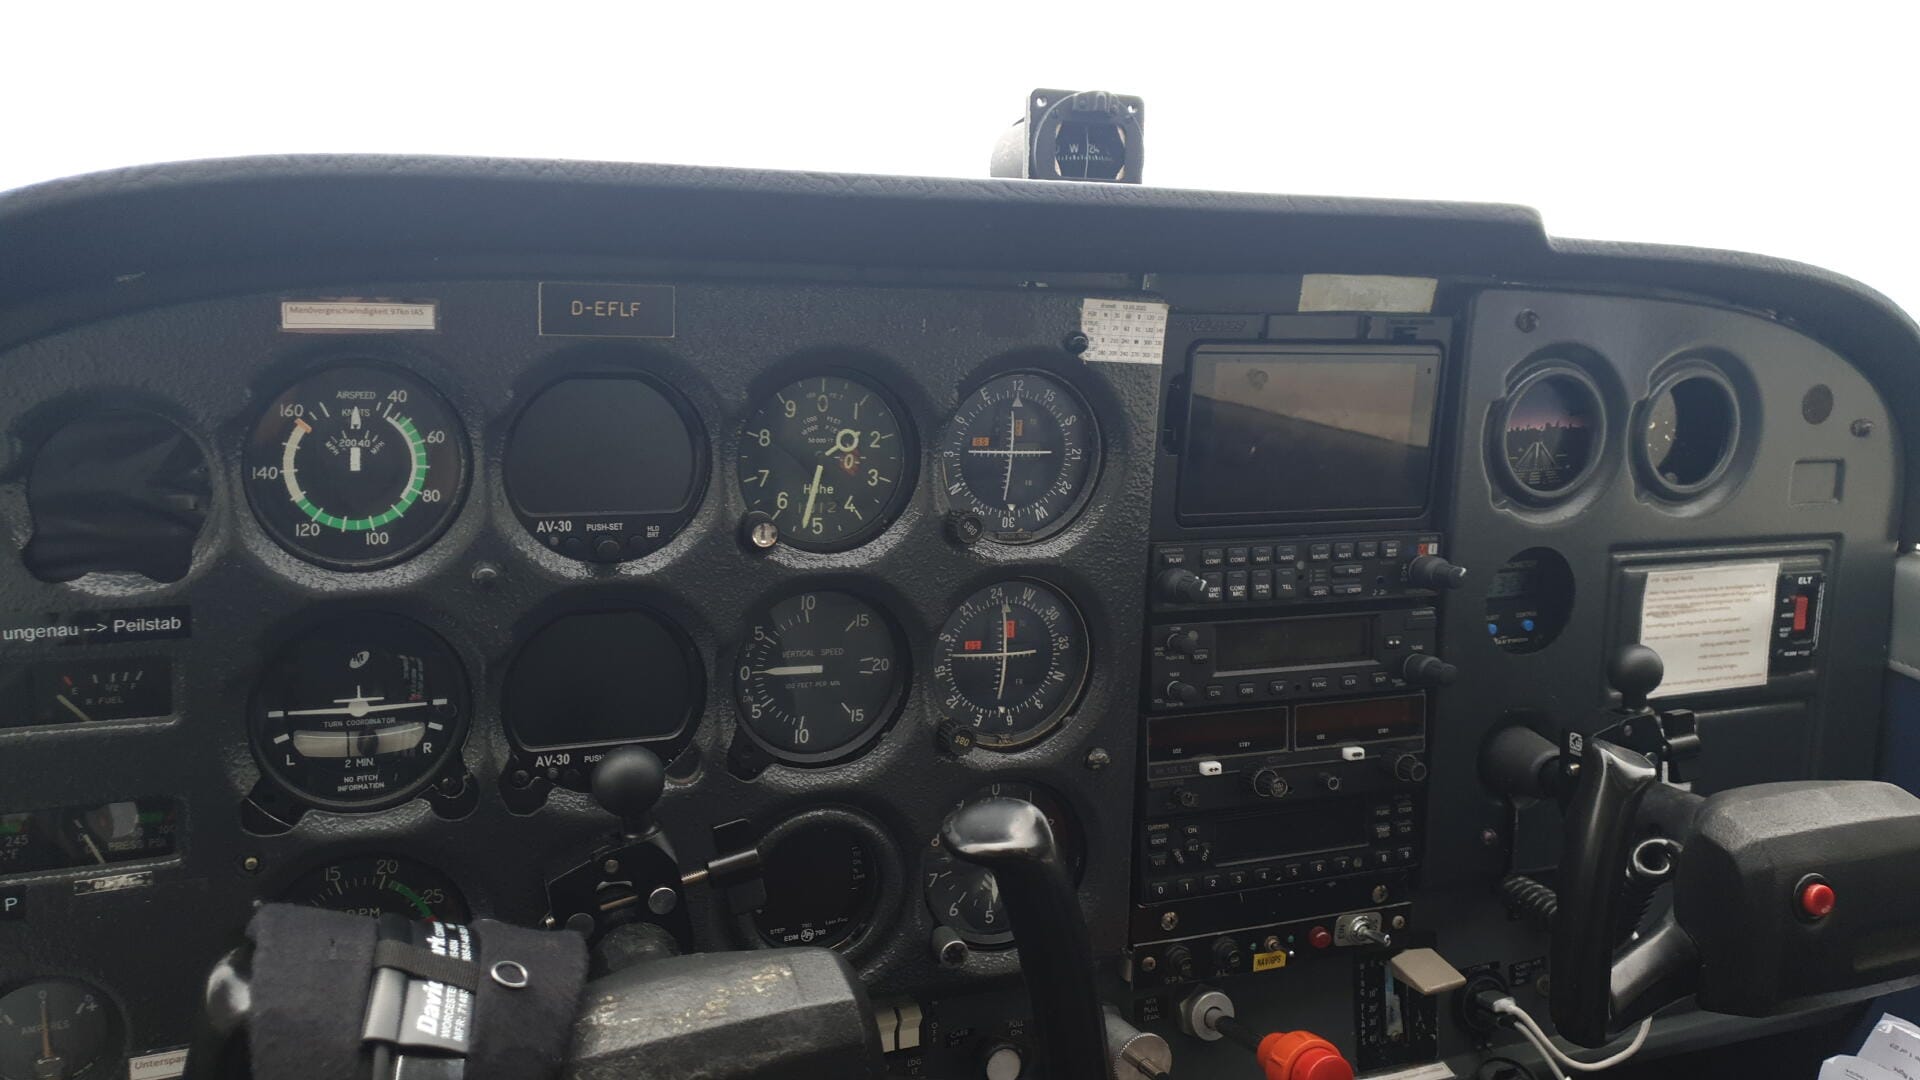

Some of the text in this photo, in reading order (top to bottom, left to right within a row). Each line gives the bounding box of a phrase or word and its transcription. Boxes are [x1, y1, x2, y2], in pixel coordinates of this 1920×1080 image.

[571, 300, 641, 317] D-EFLF
[1013, 380, 1024, 392] 12
[387, 390, 408, 402] 40
[980, 387, 990, 400] E
[1044, 388, 1056, 402] 15
[280, 404, 304, 417] 160
[341, 408, 370, 417] KNTS
[784, 400, 796, 418] 9
[427, 430, 445, 444] 60
[758, 428, 771, 447] 8
[870, 430, 881, 448] 2
[1071, 448, 1082, 460] 21
[252, 466, 278, 480] 140
[758, 470, 770, 488] 7
[867, 468, 879, 486] 3
[422, 489, 441, 502] 80
[948, 482, 962, 496] N
[776, 492, 788, 510] 6
[844, 496, 856, 512] 4
[1034, 506, 1049, 522] W
[536, 520, 572, 533] AV-30
[586, 522, 624, 532] PUSH-SET
[812, 518, 824, 534] 5
[1002, 516, 1016, 528] 30
[296, 523, 320, 537] 120
[366, 532, 389, 545] 100
[1798, 576, 1813, 584] ELT
[990, 587, 1002, 600] 24
[1022, 586, 1036, 601] W
[801, 595, 816, 611] 10
[959, 602, 974, 616] 21
[856, 614, 870, 627] 15
[1046, 606, 1060, 621] 30
[2, 625, 79, 642] ungenau
[113, 616, 182, 633] Peilstab
[754, 626, 765, 641] 5
[782, 648, 844, 658] VERTICAL SPEED
[872, 658, 889, 672] 20
[740, 666, 750, 681] 0
[752, 704, 762, 719] 5
[851, 708, 864, 722] 15
[324, 717, 396, 728] TURN COORDINATOR
[794, 728, 809, 744] 10
[423, 742, 432, 754] R
[286, 754, 296, 766] L
[344, 759, 352, 768] 2
[535, 754, 570, 768] AV-30
[344, 774, 378, 784] NO PITCH
[337, 782, 385, 792] INFORMATION
[5, 835, 29, 848] 245
[325, 866, 341, 881] 15
[376, 859, 399, 876] 20
[928, 873, 938, 888] 7
[422, 888, 444, 904] 25
[1158, 886, 1164, 894] 0
[950, 902, 959, 916] 6
[985, 910, 994, 924] 5
[21, 1019, 70, 1035] AMPRES
